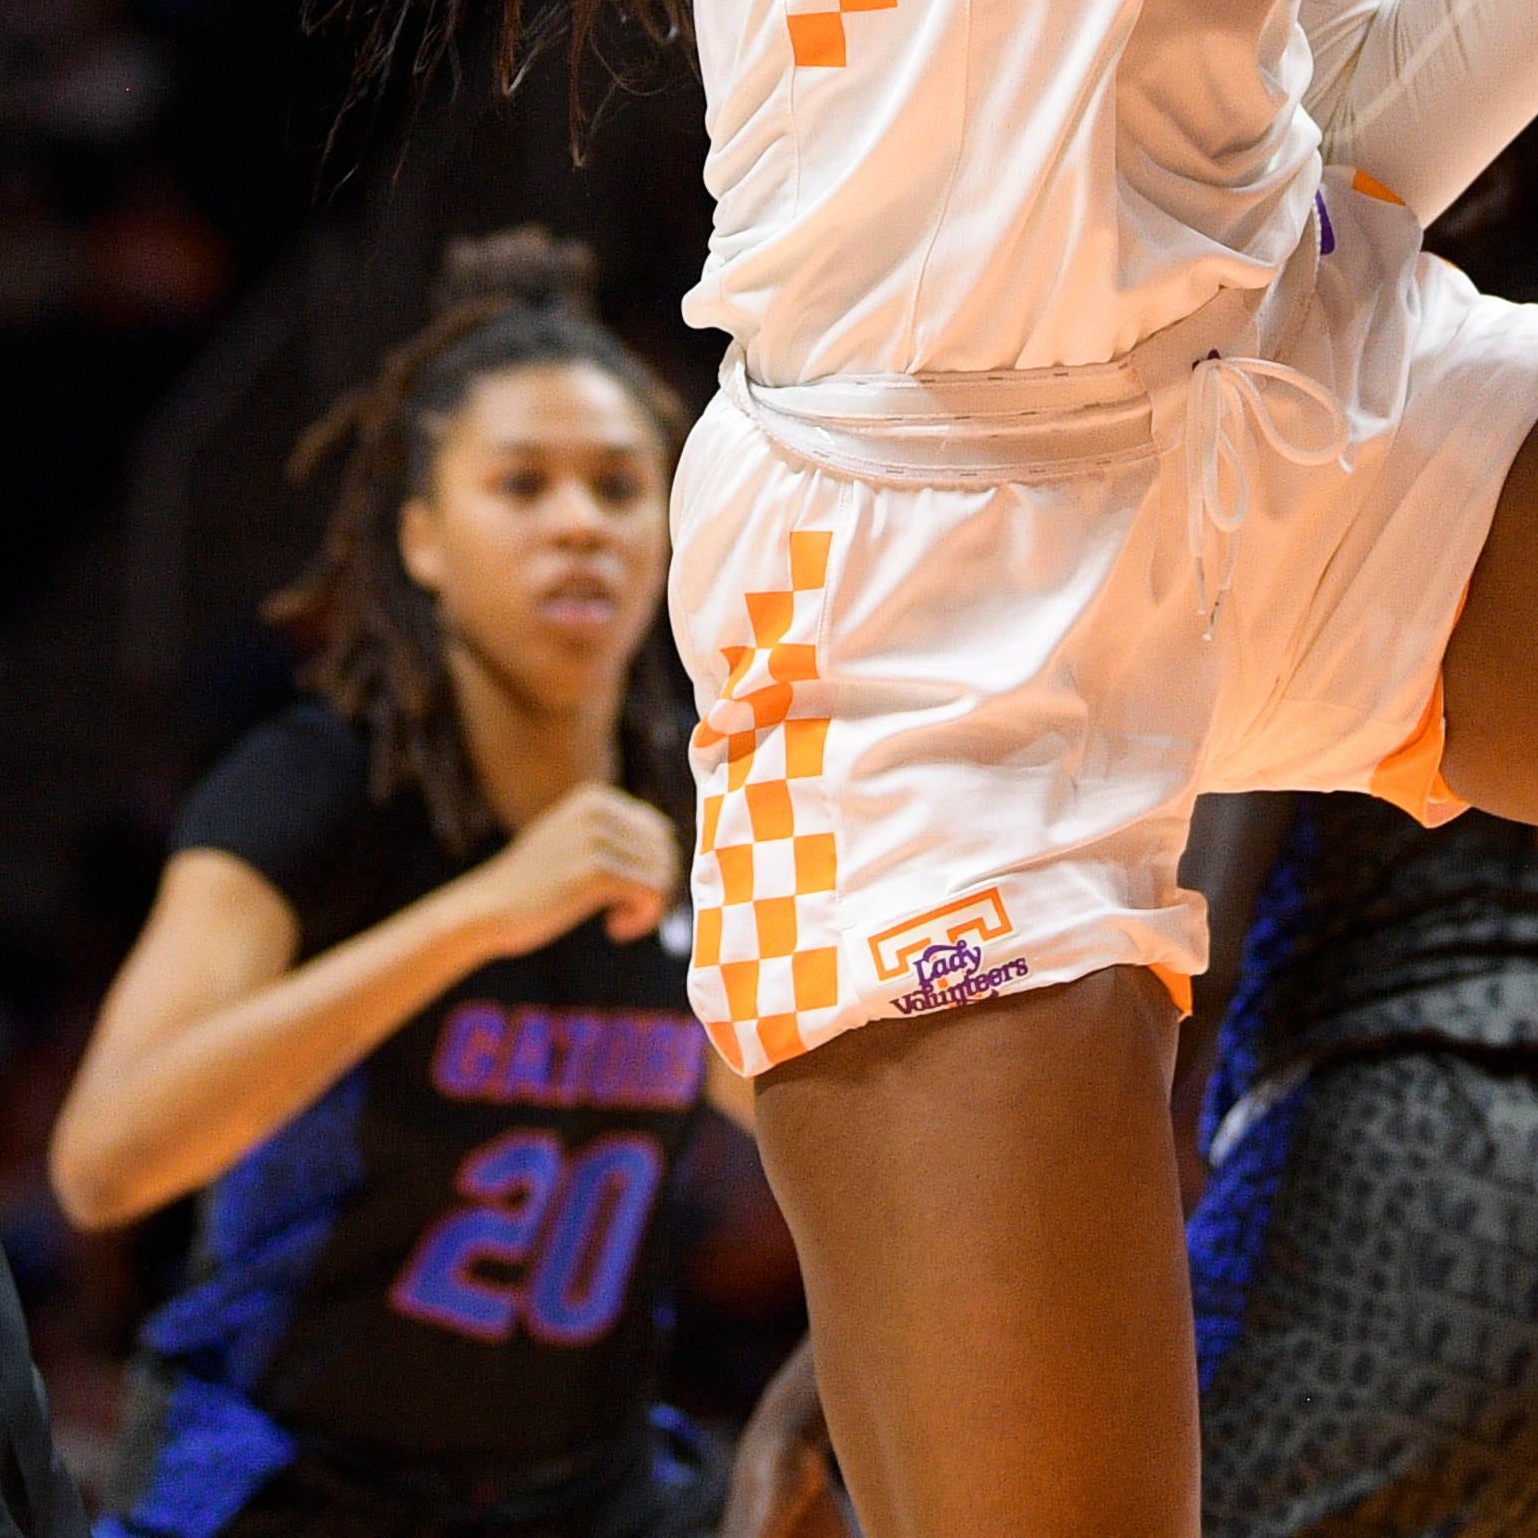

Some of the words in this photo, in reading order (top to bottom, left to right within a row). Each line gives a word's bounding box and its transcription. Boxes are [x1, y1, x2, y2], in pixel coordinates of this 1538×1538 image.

[889, 957, 1029, 1015] Volunteers
[913, 939, 981, 987] Lady
[390, 1129, 660, 1347] 20
